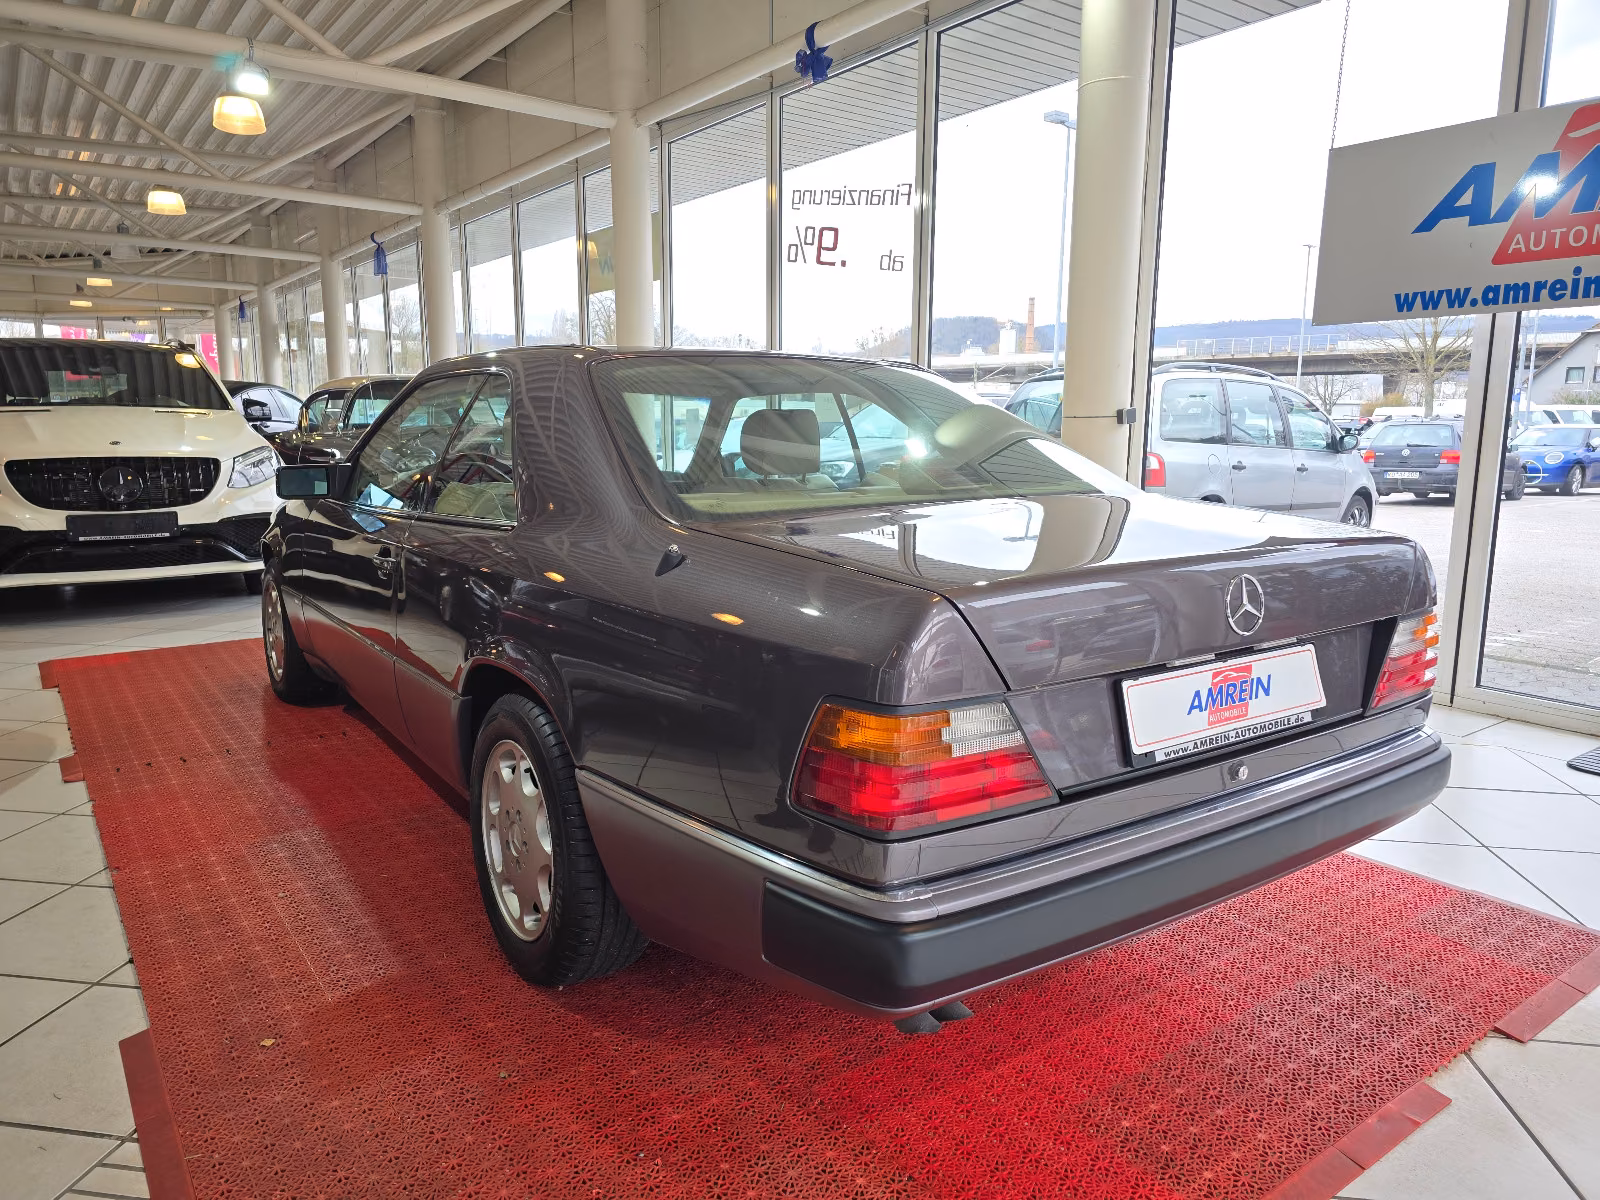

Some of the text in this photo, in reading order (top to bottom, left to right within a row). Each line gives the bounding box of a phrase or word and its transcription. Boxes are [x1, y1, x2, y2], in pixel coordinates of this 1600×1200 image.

[1411, 143, 1600, 235] AM
[1188, 674, 1271, 714] AMREIN
[1209, 705, 1247, 723] AUTOMOBILE
[1163, 714, 1306, 760] www.AMREIN-AUTOMOBILE.de
